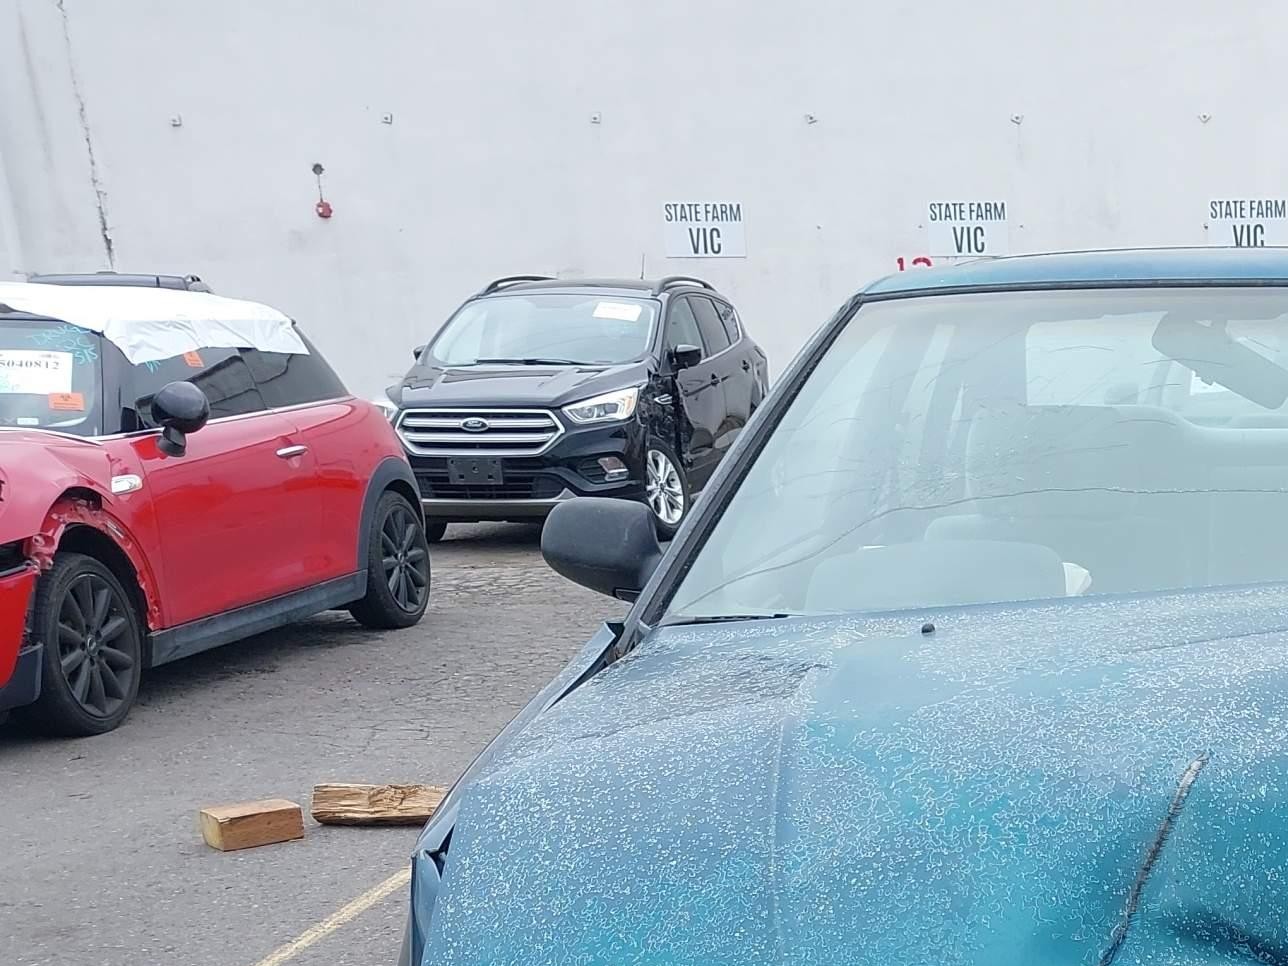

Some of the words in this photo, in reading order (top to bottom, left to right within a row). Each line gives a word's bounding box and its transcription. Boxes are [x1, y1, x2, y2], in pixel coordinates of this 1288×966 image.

[664, 203, 701, 222] STATE
[704, 203, 742, 222] FARM
[929, 202, 966, 221] STATE
[968, 202, 1006, 221] FARM
[1210, 200, 1246, 219] STATE
[1249, 199, 1286, 218] FARM
[688, 227, 722, 255] VIC
[952, 226, 985, 253] VIC
[1232, 223, 1265, 248] VIC
